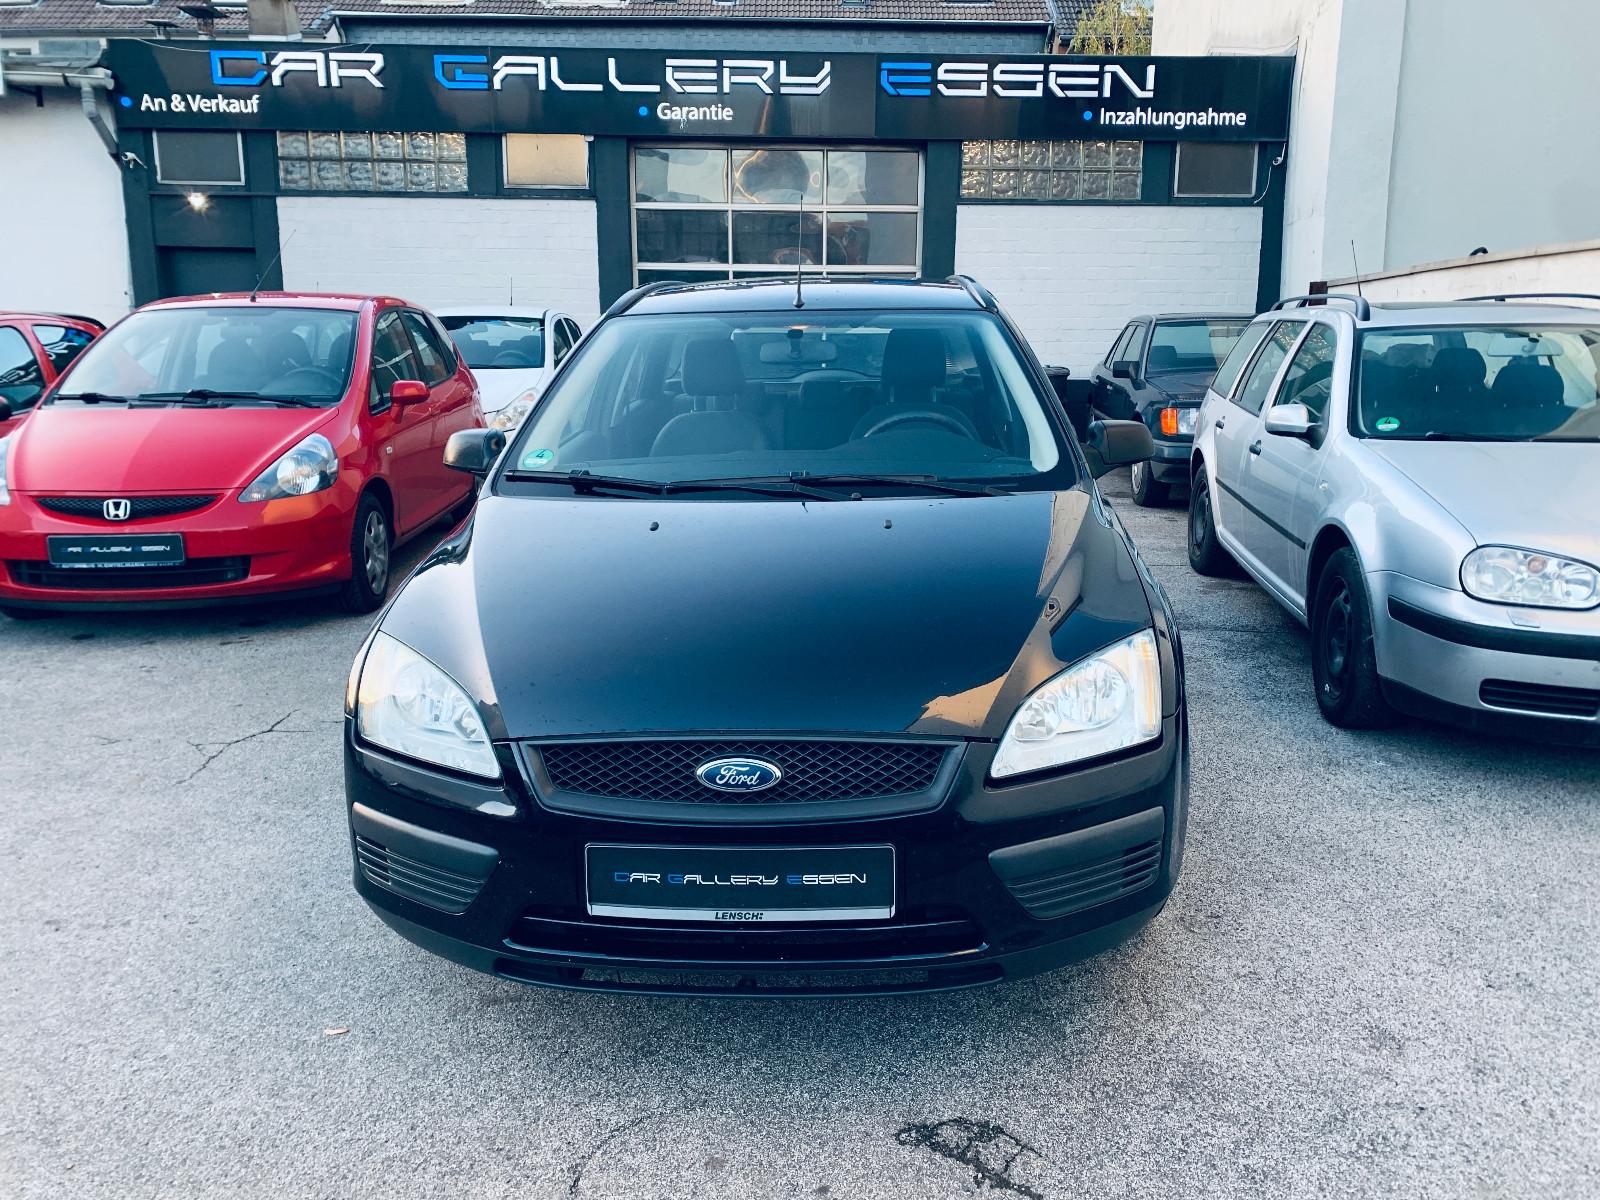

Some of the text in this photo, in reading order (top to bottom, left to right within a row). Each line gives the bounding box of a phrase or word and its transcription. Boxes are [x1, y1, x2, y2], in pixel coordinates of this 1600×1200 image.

[210, 50, 1156, 99] CAR GALLERY ESSEN
[140, 94, 259, 113] An & Verkauf
[656, 102, 734, 122] Garantie
[1100, 107, 1247, 130] Inzahlungnahme
[716, 766, 760, 785] Ford
[615, 871, 867, 886] CAR GALLERY ESSEN
